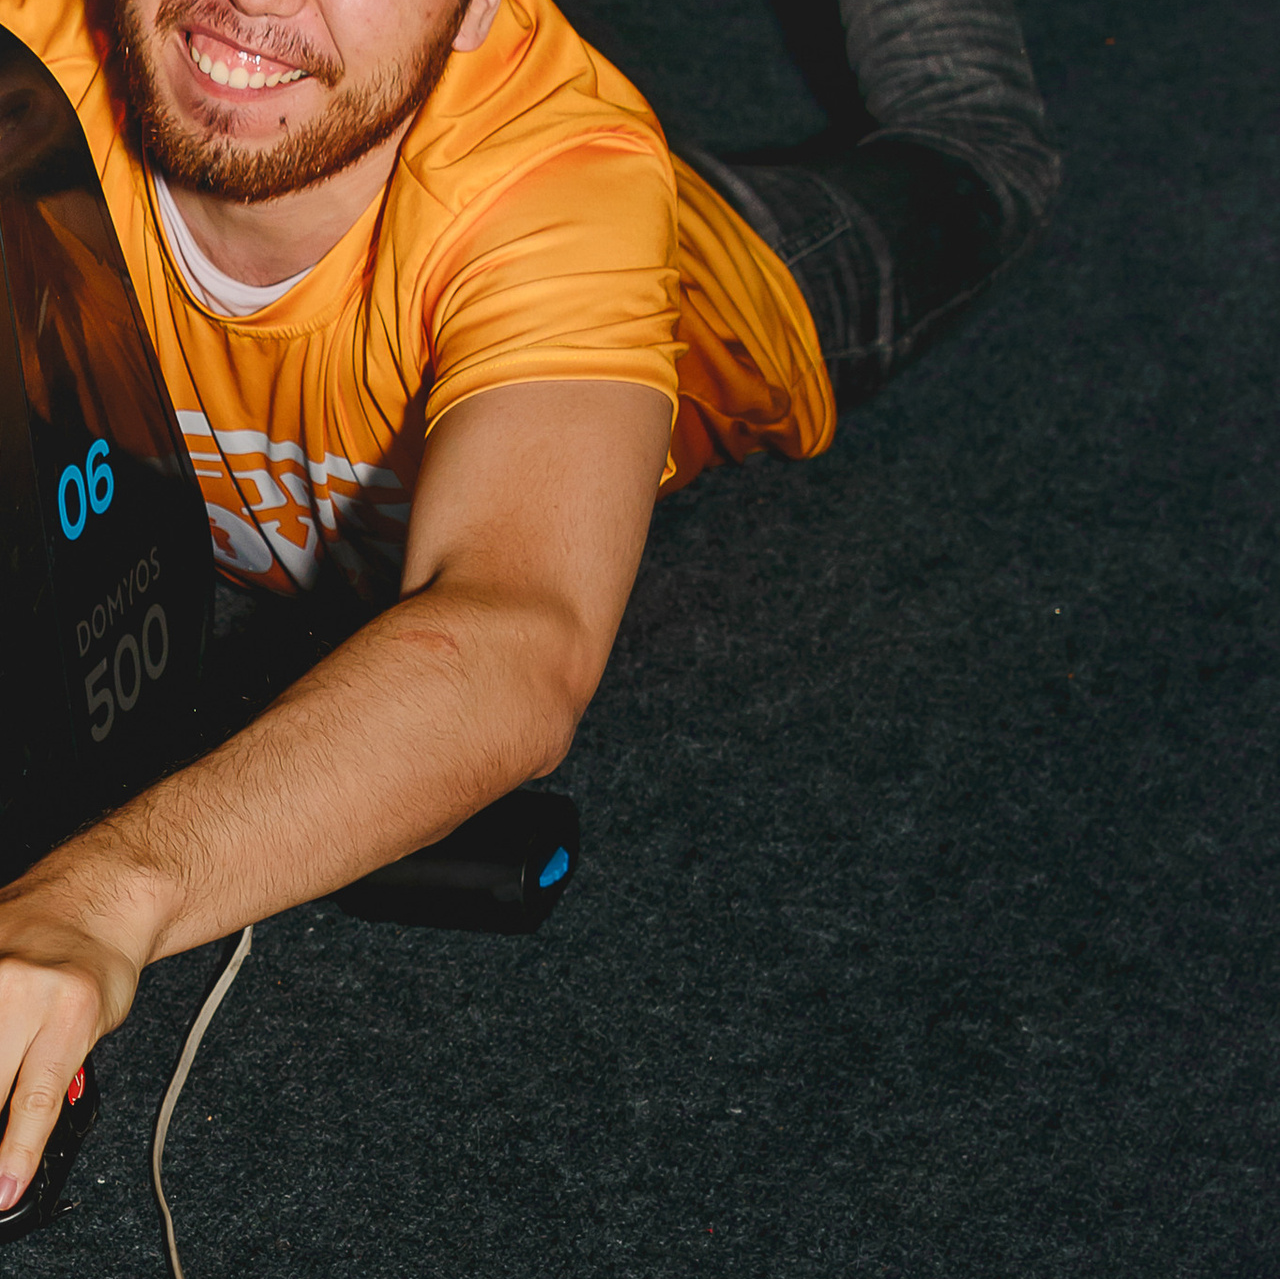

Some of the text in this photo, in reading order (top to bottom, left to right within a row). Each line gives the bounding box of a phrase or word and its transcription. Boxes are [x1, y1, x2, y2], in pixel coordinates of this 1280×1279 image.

[58, 438, 115, 541] 06
[76, 546, 161, 657] DOMYOS
[84, 603, 169, 743] 500
